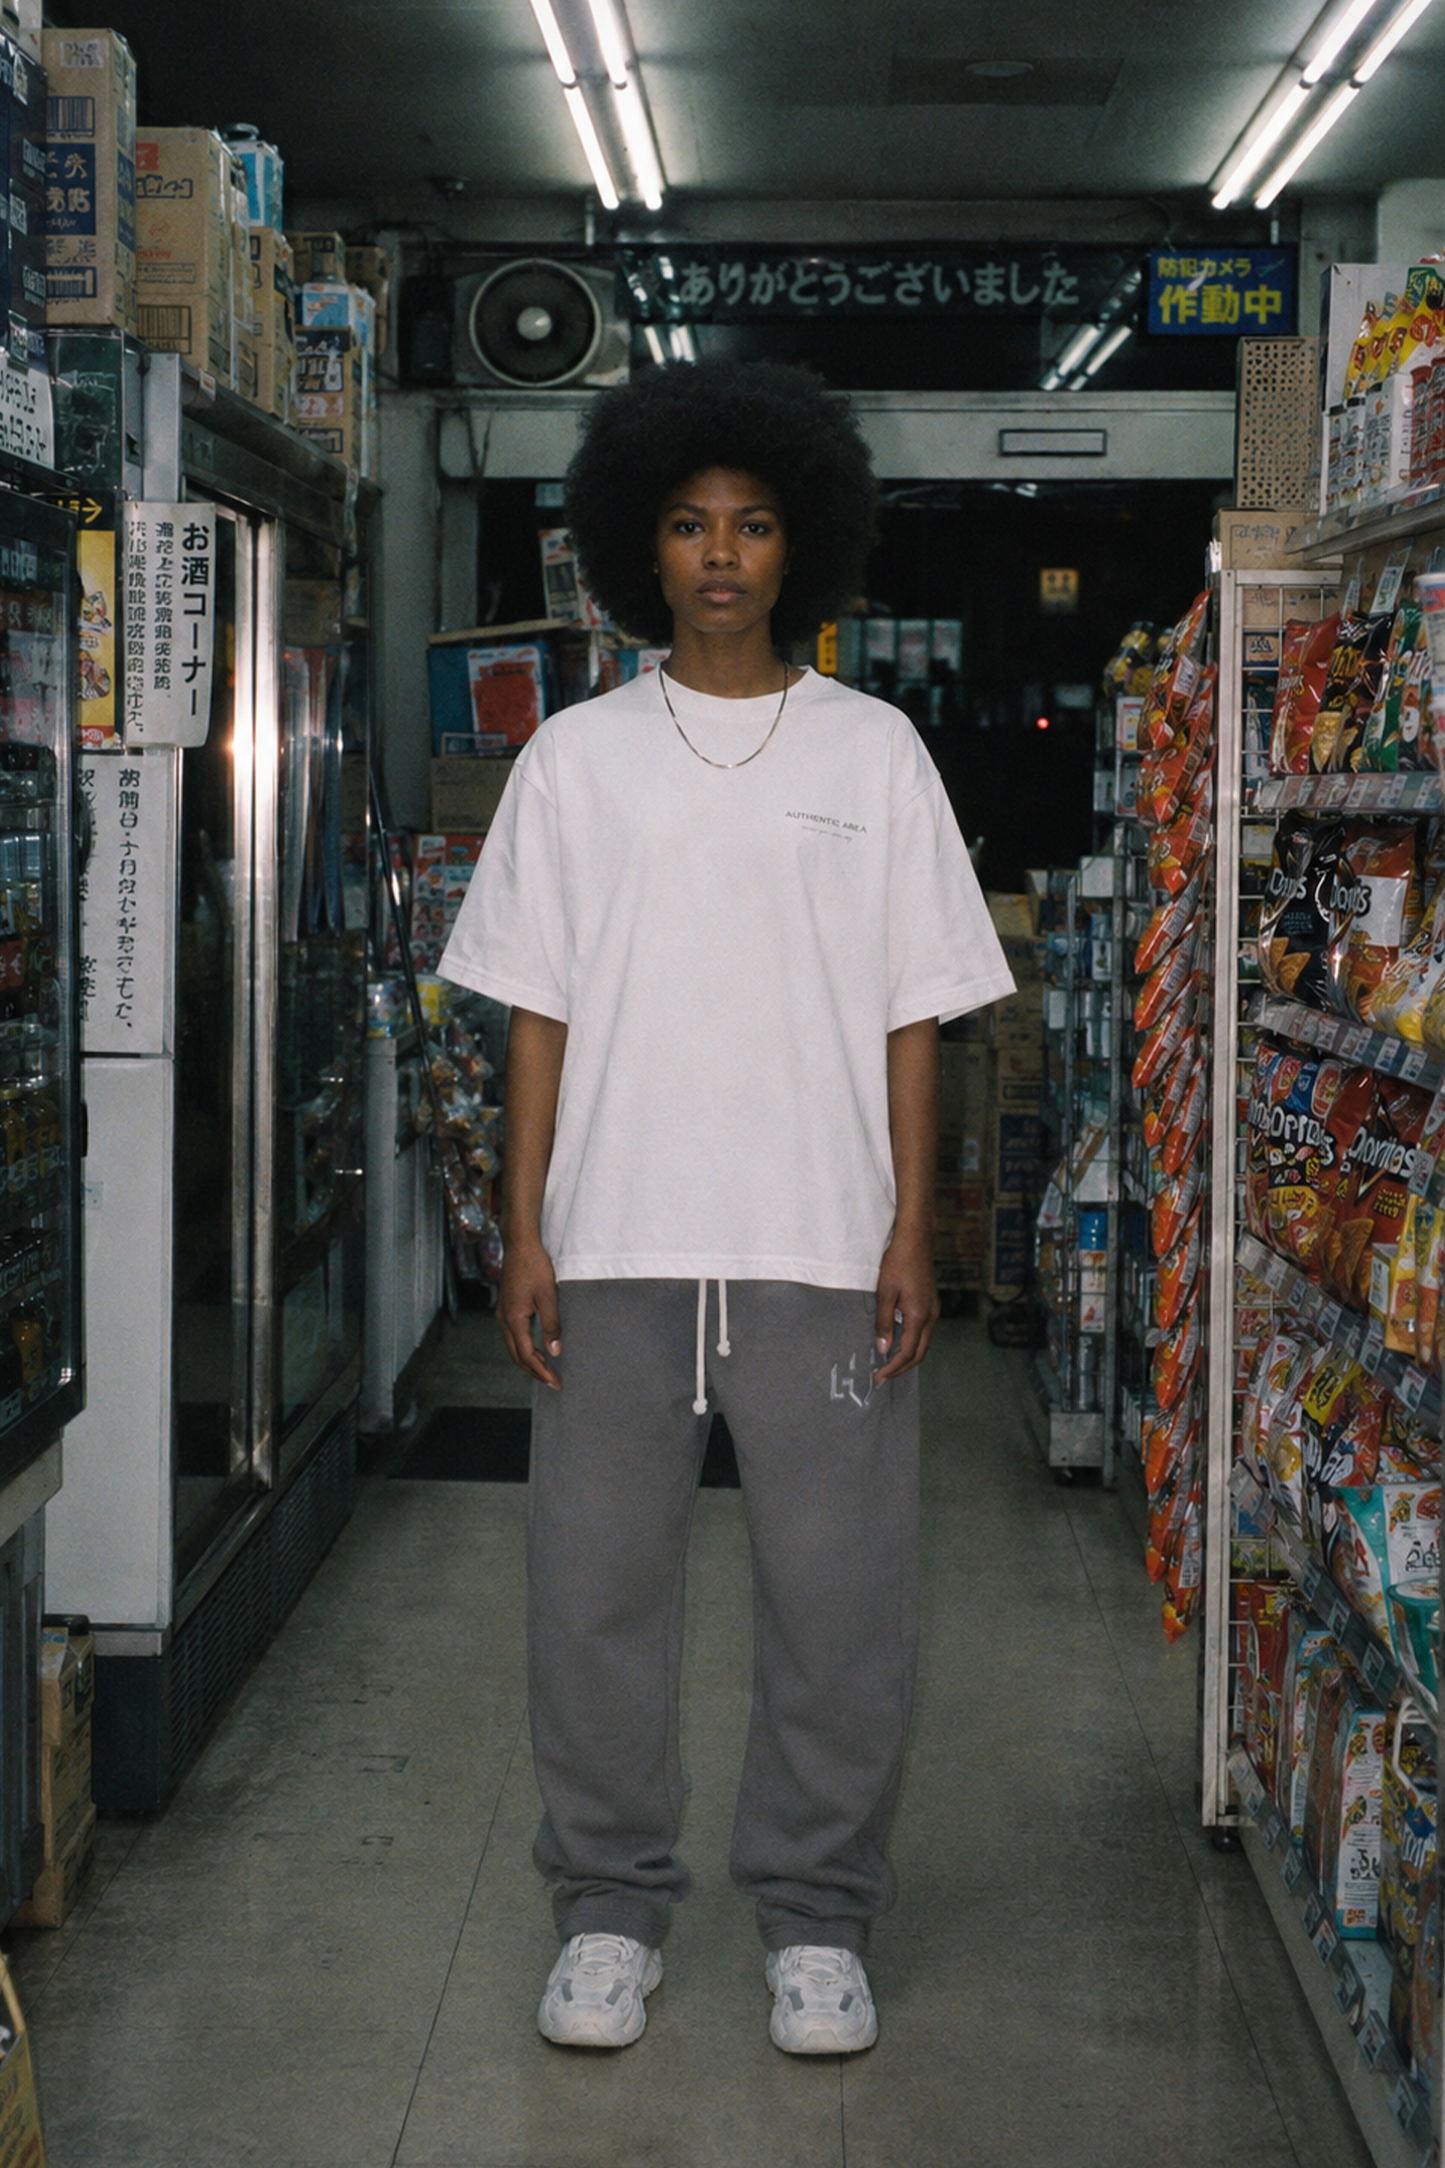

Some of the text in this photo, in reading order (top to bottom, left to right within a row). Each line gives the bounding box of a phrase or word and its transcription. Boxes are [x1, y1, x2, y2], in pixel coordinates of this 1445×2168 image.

[678, 260, 1080, 306] ありがとうございました
[1157, 256, 1252, 278] 防犯カメラ
[1157, 283, 1282, 325] 作動中
[181, 521, 210, 716] お酒コーナー
